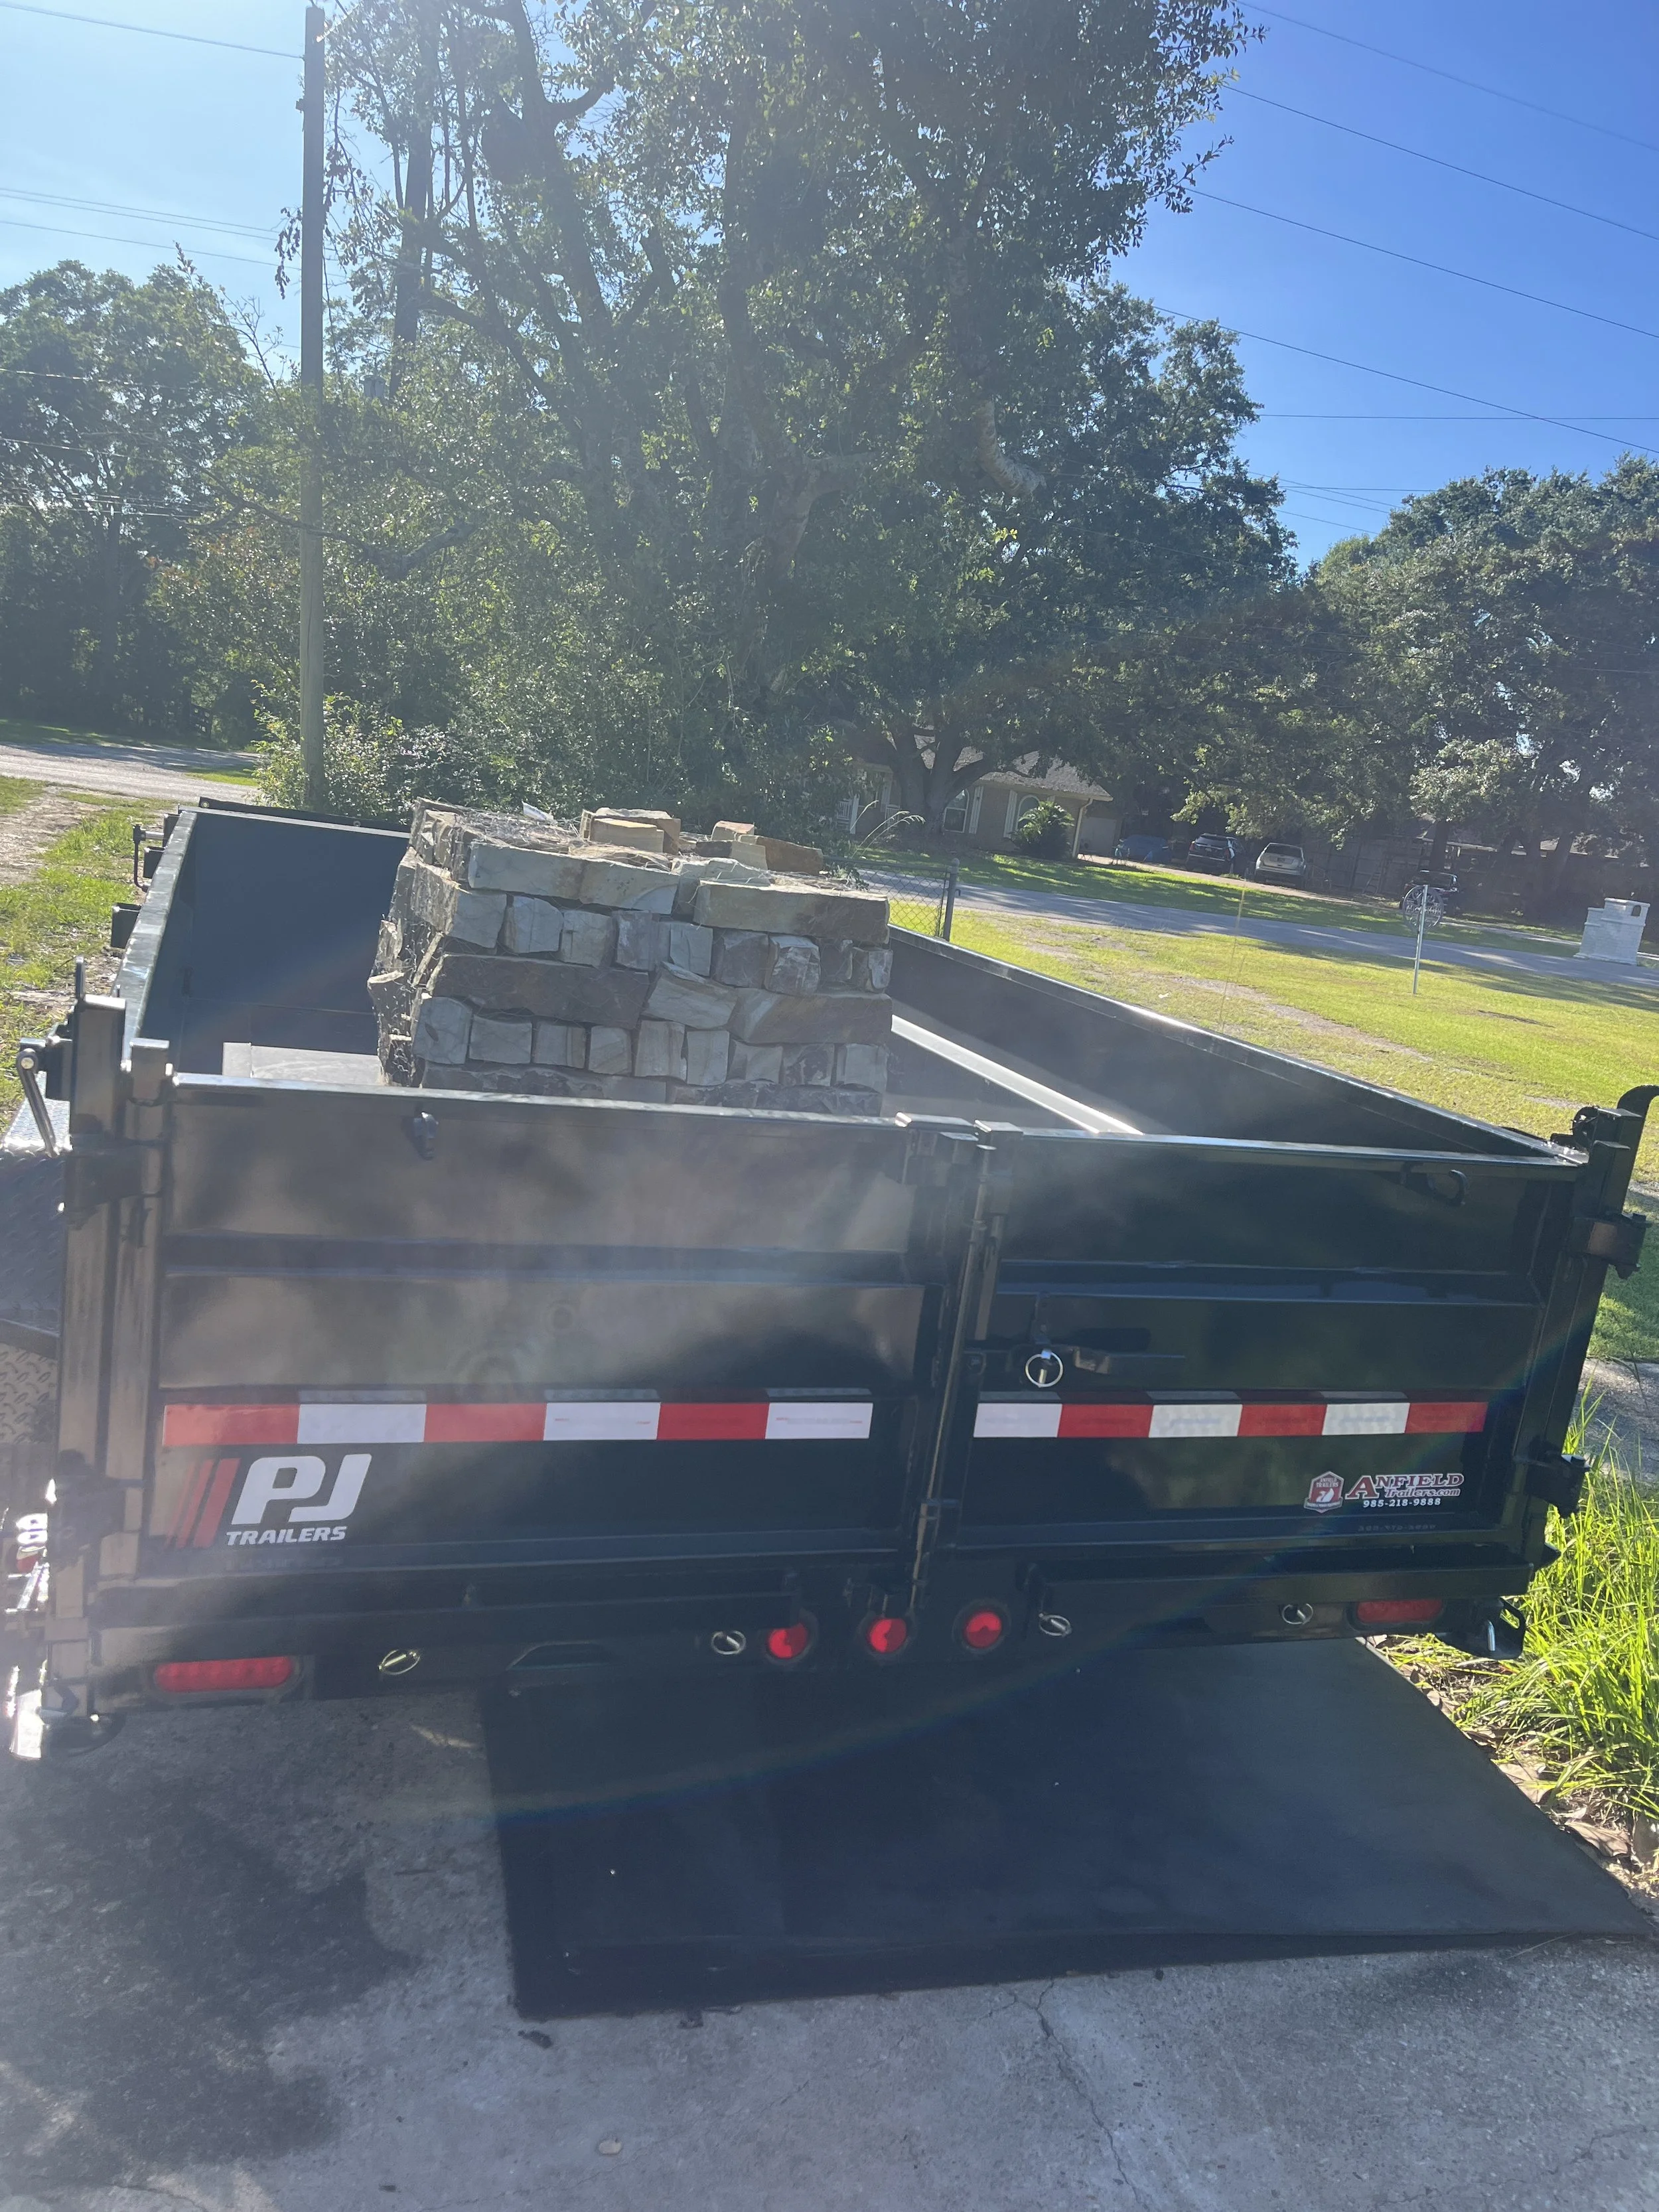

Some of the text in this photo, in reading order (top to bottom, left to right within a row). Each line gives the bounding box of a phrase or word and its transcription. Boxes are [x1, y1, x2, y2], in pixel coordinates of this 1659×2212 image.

[232, 1453, 372, 1525] PJ
[1344, 1473, 1465, 1500] ANFIELD
[1384, 1487, 1461, 1499] Trailers.com
[1362, 1497, 1441, 1508] 985-218-9888
[226, 1526, 348, 1546] TRAILERS
